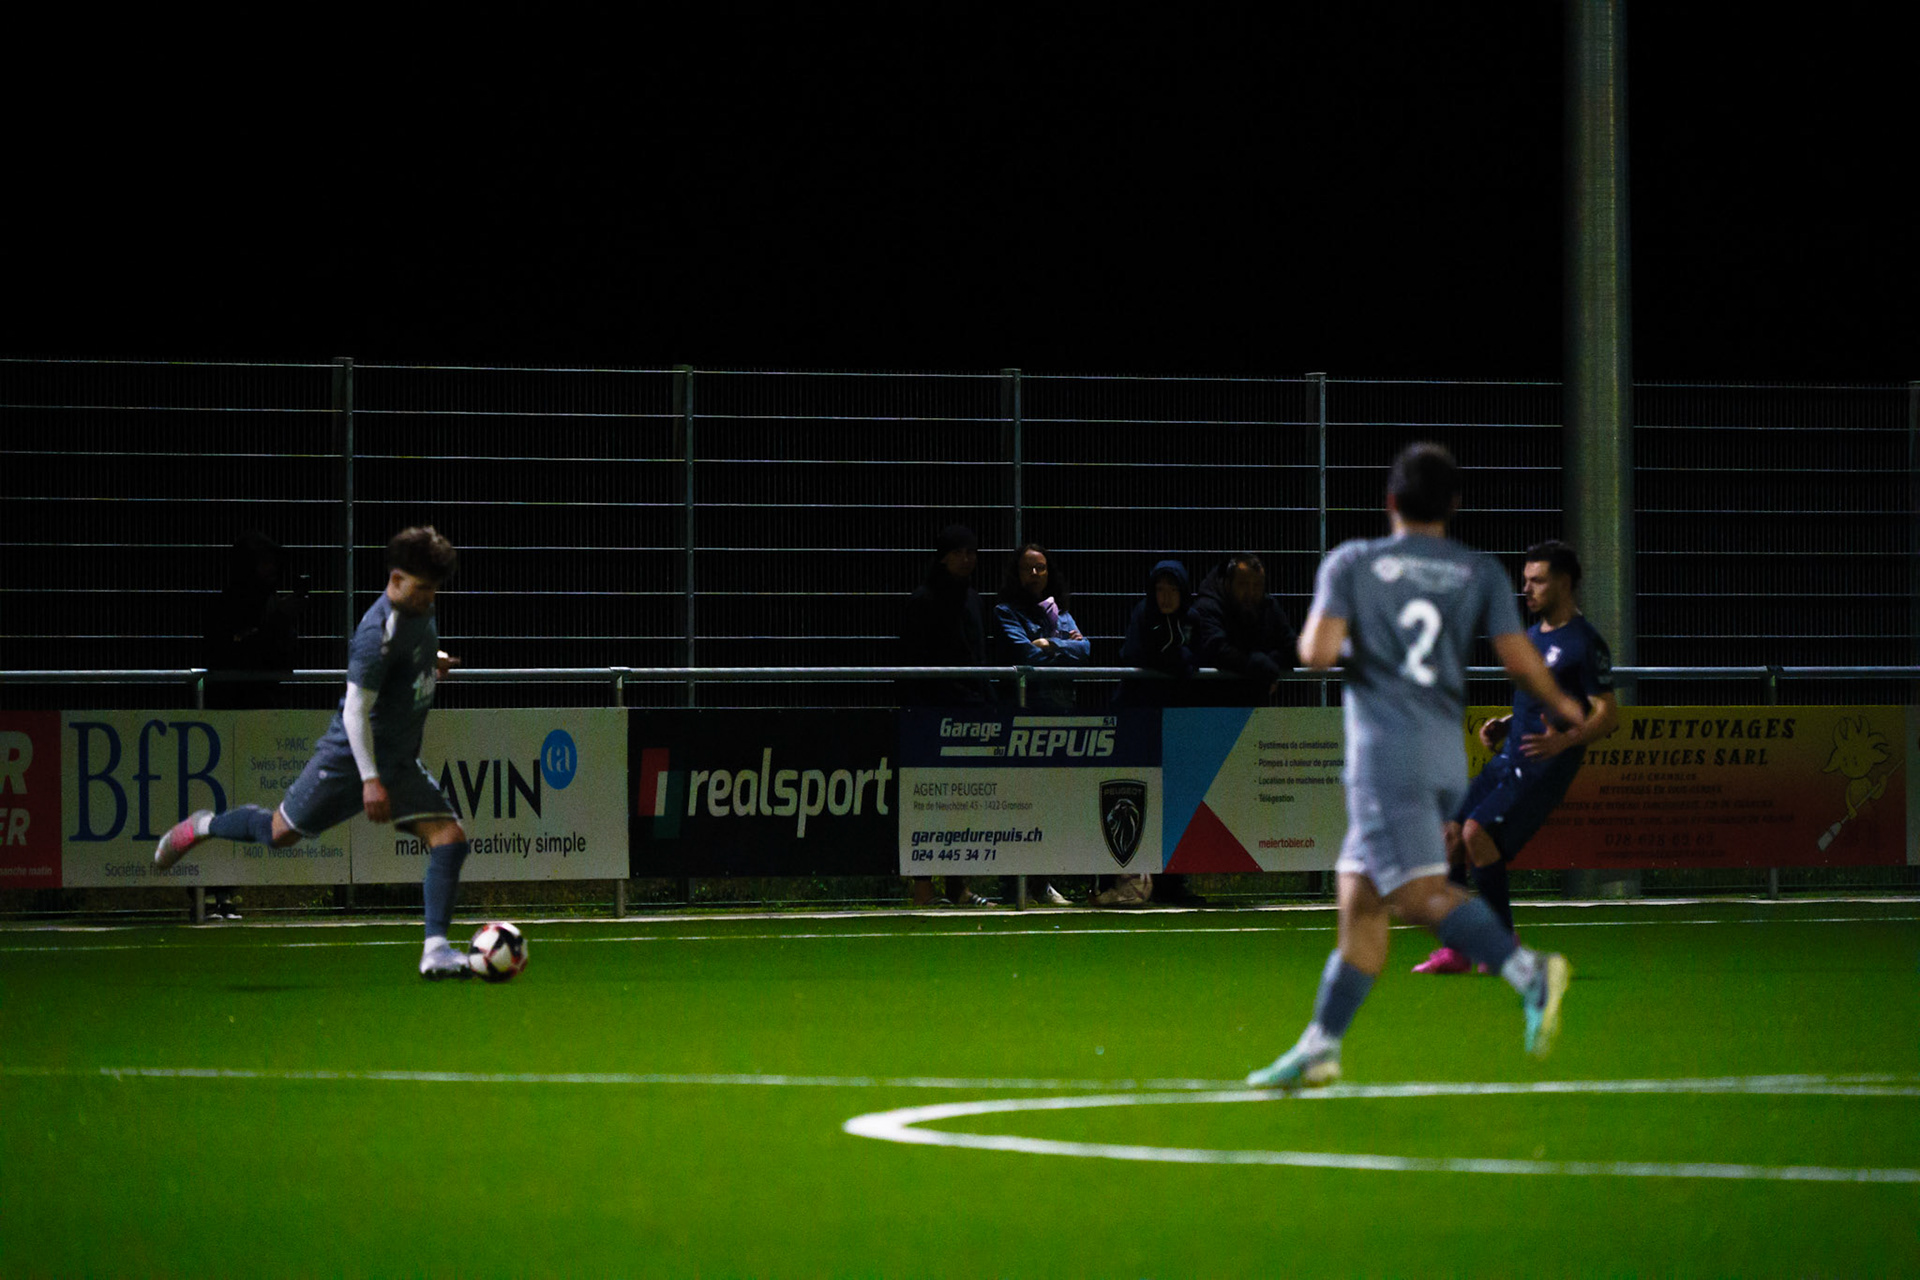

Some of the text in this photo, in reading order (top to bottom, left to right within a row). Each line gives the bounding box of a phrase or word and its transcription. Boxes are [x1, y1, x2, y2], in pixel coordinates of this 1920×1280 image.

[1399, 598, 1443, 687] 2
[940, 717, 1002, 742] Garage
[1630, 718, 1796, 740] NETTOYAGES
[275, 736, 309, 752] Y-PARC
[1006, 729, 1117, 757] REPUIS
[0, 731, 33, 794] R
[249, 756, 275, 771] Swiss
[1582, 748, 1768, 766] TISERVICES SARL
[68, 719, 227, 841] BfB
[259, 776, 278, 790] Rue
[440, 758, 541, 819] AVIN
[687, 747, 893, 838] realsport
[913, 783, 998, 796] AGENT PEUGEOT
[1103, 787, 1143, 796] PEUGEOT
[925, 801, 934, 810] de
[396, 832, 586, 858] mak reativity simple
[911, 827, 1043, 846] garagedurepuis.ch
[243, 845, 343, 858] 1400 Yverdon-les-Bains
[911, 849, 997, 861] 024 445 34 71
[105, 861, 146, 877] Sociétés
